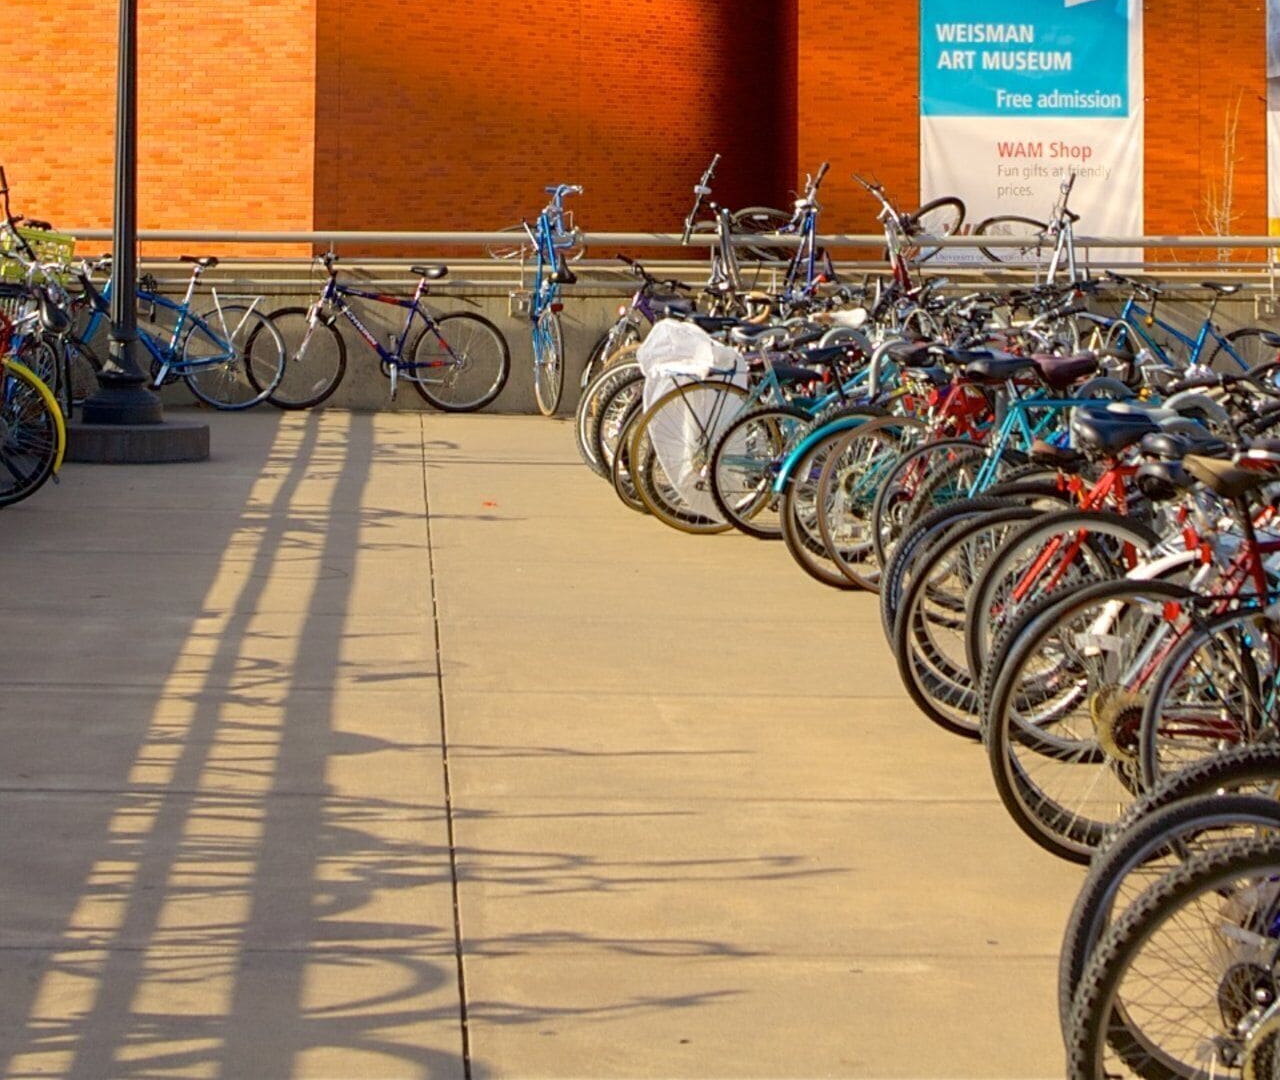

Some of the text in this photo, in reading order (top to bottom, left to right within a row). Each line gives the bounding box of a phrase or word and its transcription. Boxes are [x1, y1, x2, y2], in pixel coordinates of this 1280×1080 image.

[936, 23, 1034, 43] WEISMAN
[937, 50, 1072, 71] ART MUSEUM
[996, 89, 1122, 108] Free admission
[997, 142, 1093, 162] WAM Shop
[997, 165, 1019, 177] Fun
[1023, 164, 1048, 180] gifts
[1052, 166, 1065, 177] at
[997, 184, 1034, 198] prices.
